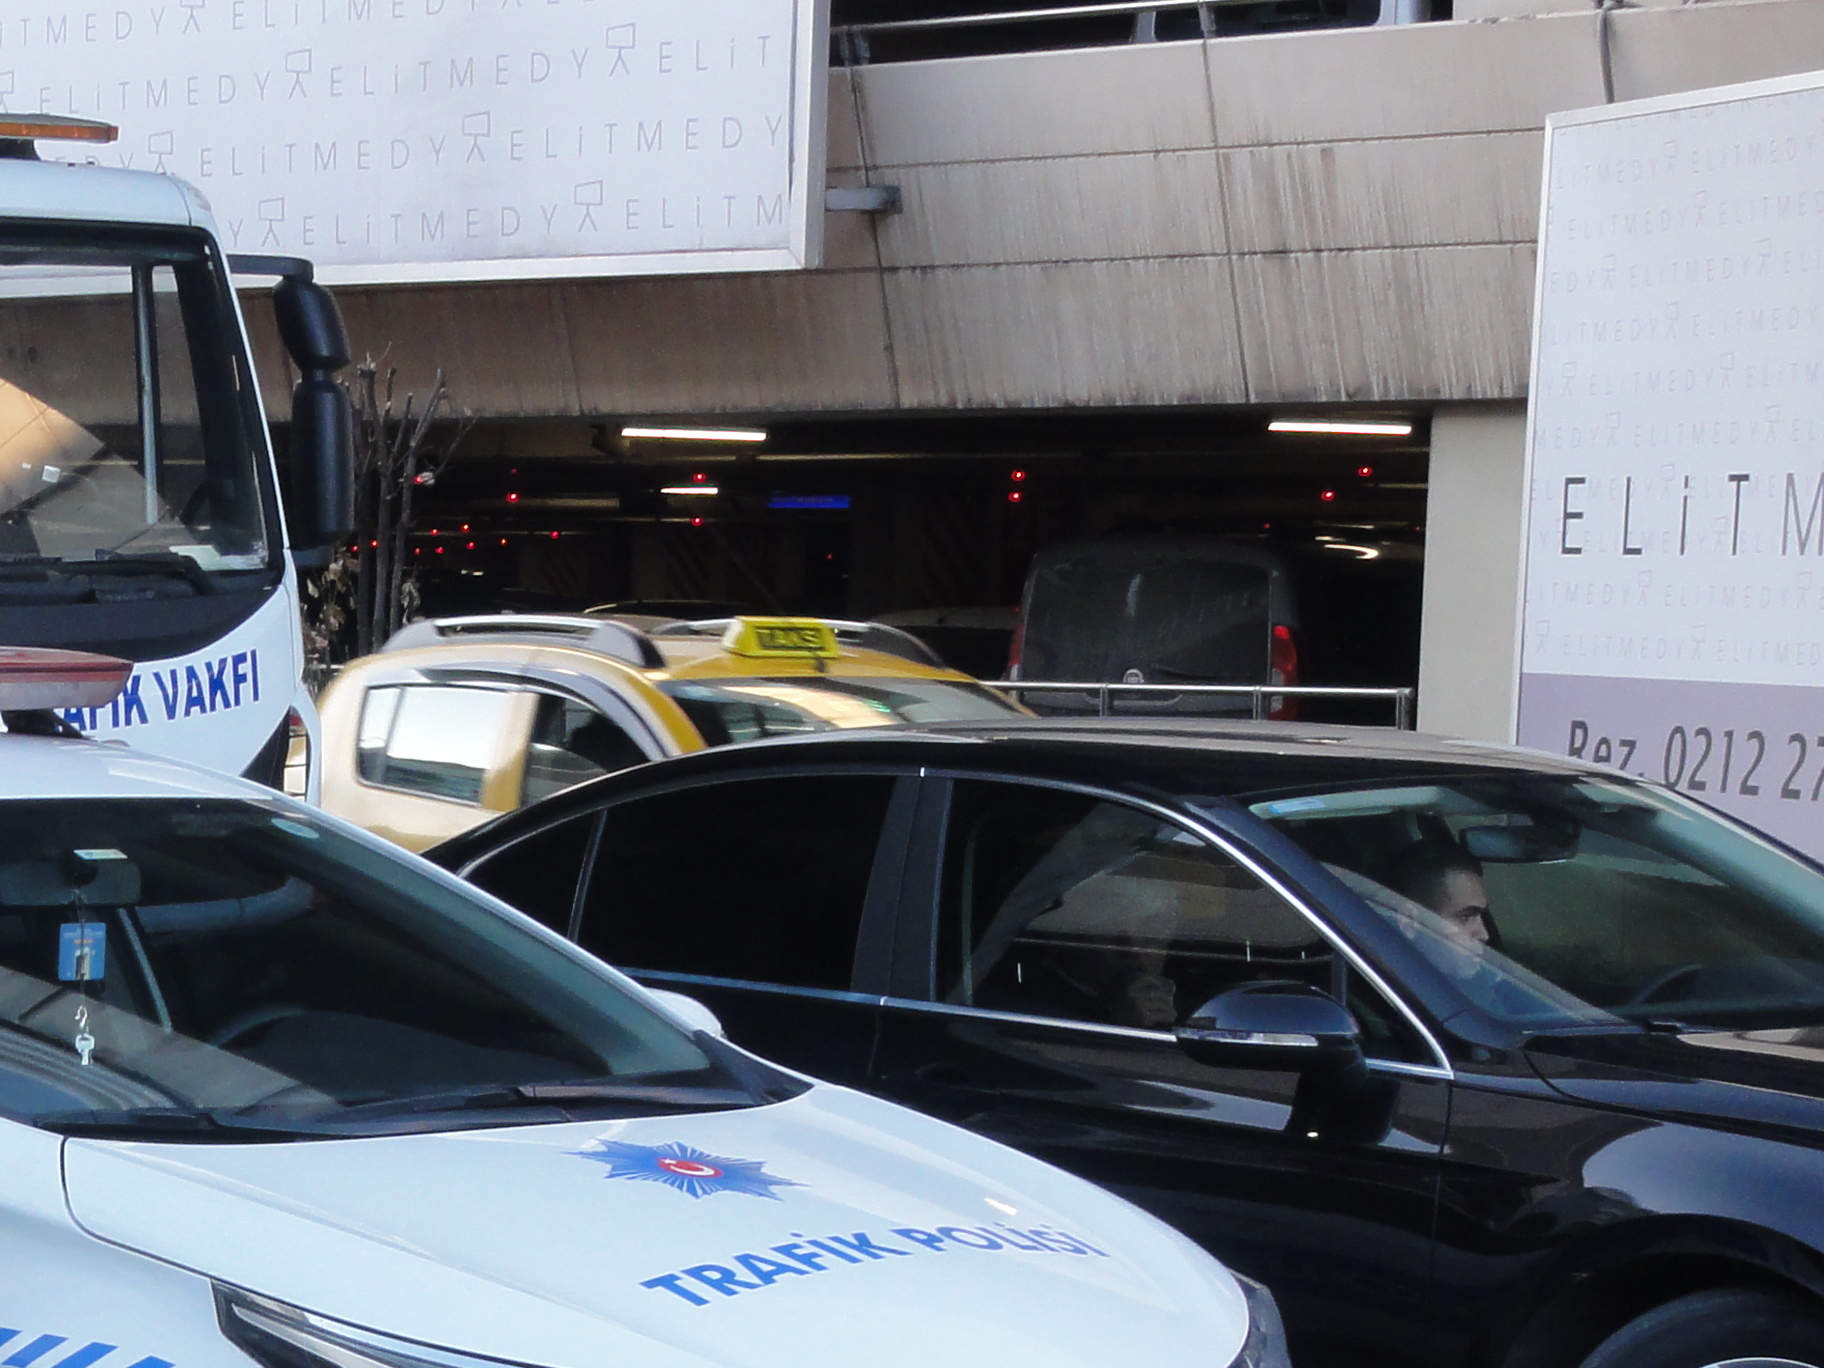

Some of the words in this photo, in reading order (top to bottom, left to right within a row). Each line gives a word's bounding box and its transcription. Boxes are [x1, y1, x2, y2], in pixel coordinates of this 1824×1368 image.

[152, 648, 261, 721] VAKFI
[1663, 725, 1768, 796] 0212
[639, 1232, 914, 1307] TRAFİK
[889, 1221, 1112, 1259] POLİSİ
